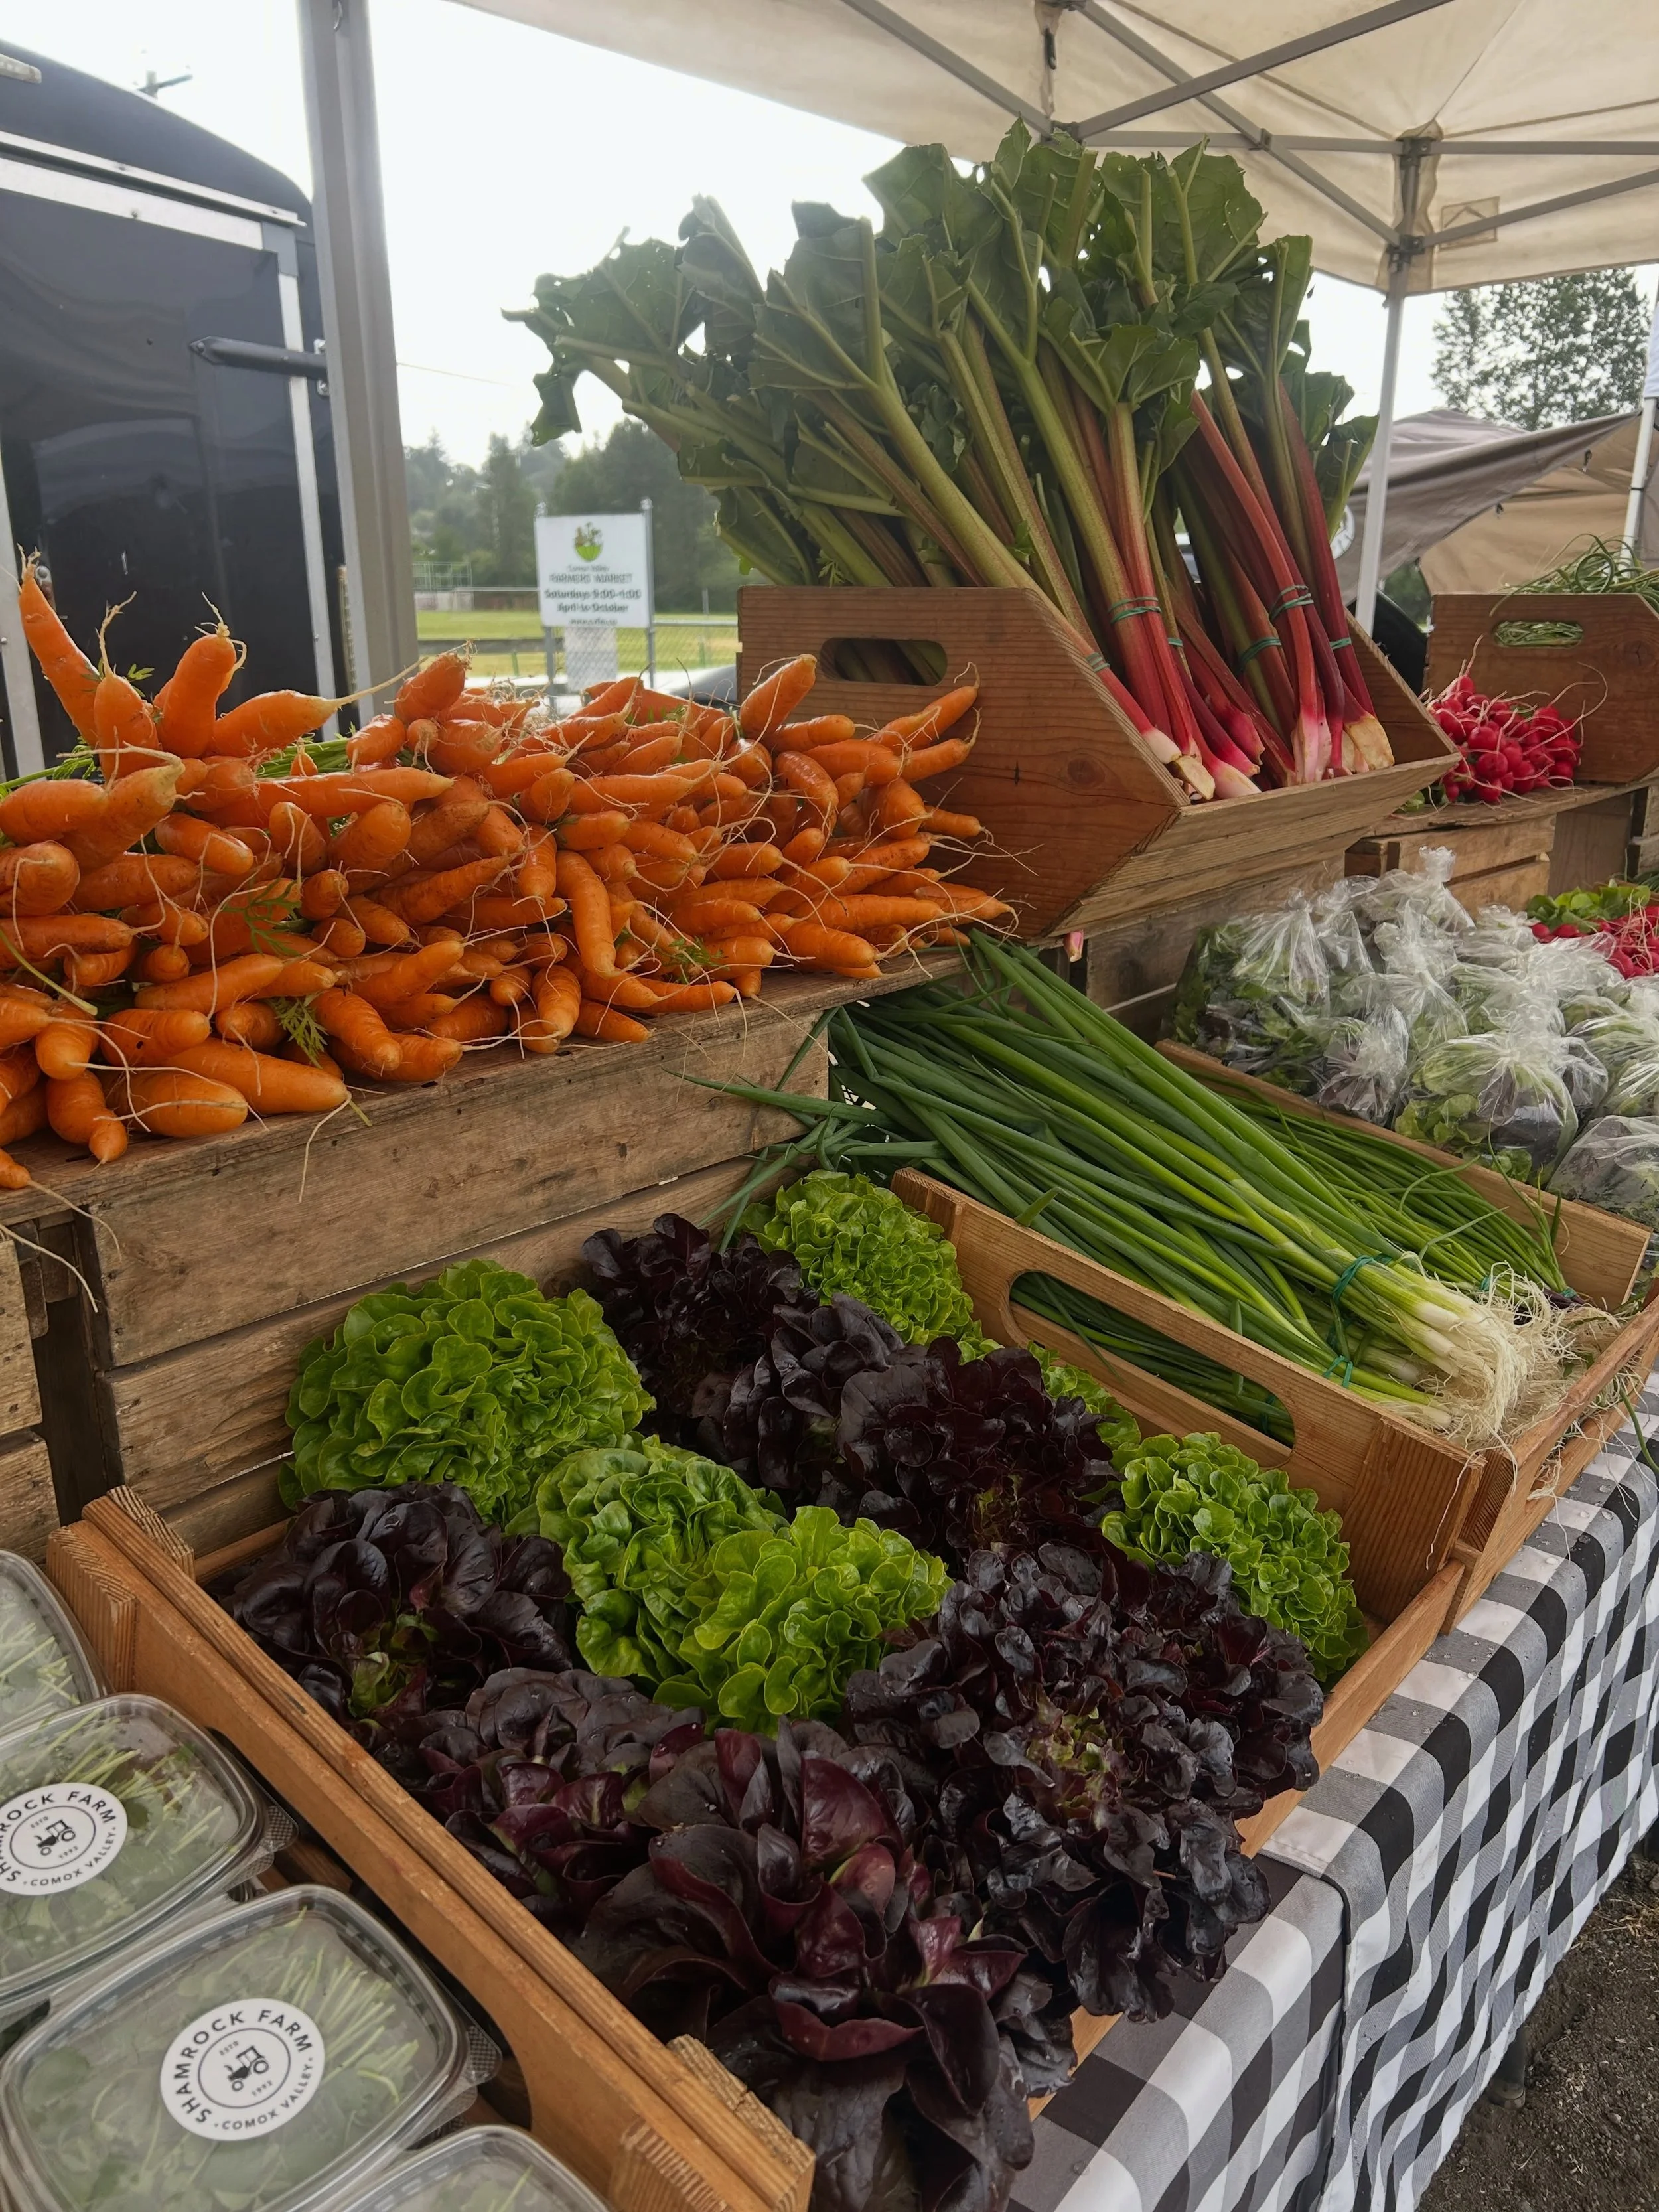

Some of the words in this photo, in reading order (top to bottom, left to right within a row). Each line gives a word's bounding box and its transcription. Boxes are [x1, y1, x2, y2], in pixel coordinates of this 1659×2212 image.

[557, 603, 577, 613] April
[592, 603, 628, 613] October
[595, 573, 632, 583] MARKET
[0, 1793, 54, 1882] SHROCK
[67, 1791, 116, 1823] FARM
[30, 1868, 83, 1886] COMOX
[84, 1832, 116, 1868] VALLEY
[173, 2011, 244, 2123] SHAMROCK
[257, 2010, 313, 2052] FARM
[222, 2109, 279, 2130] COMOX
[281, 2064, 313, 2108] VALLEY
